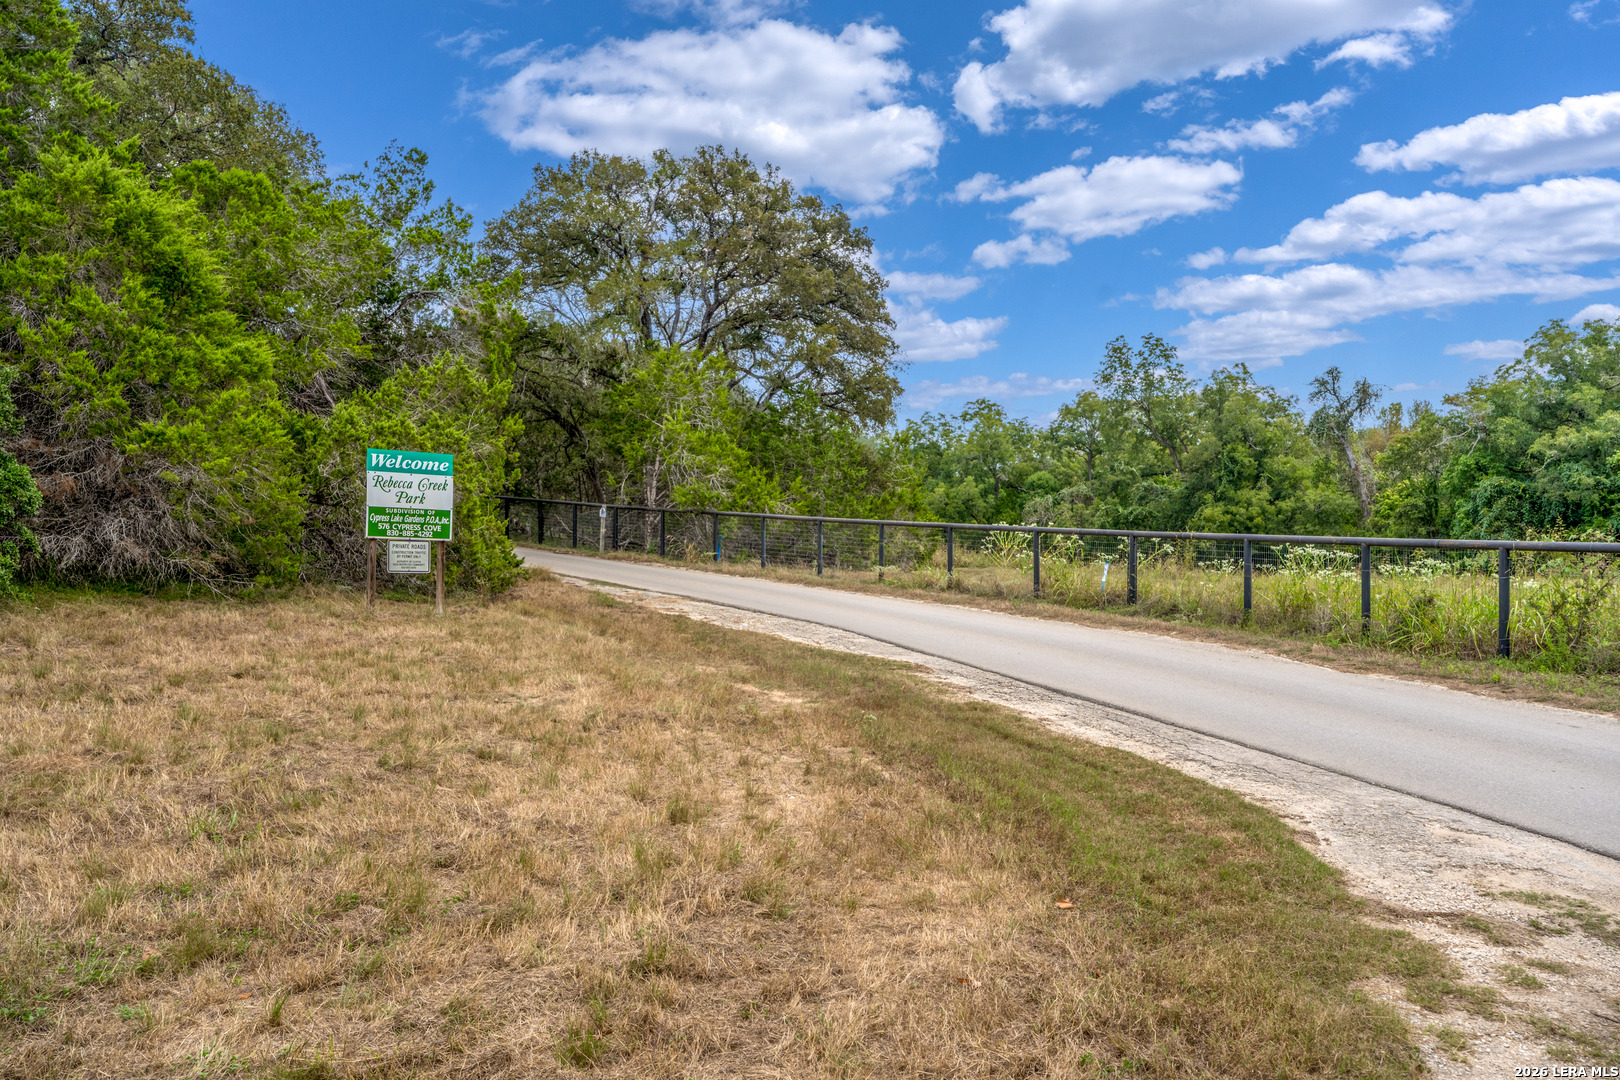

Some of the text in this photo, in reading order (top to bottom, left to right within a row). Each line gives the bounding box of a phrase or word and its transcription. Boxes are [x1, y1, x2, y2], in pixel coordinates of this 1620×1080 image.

[371, 453, 449, 471] Welcome
[372, 474, 413, 493] Rebecca
[395, 490, 426, 505] Park
[369, 513, 390, 523] Cypress
[390, 513, 403, 522] Lake
[404, 514, 425, 524] Gardens
